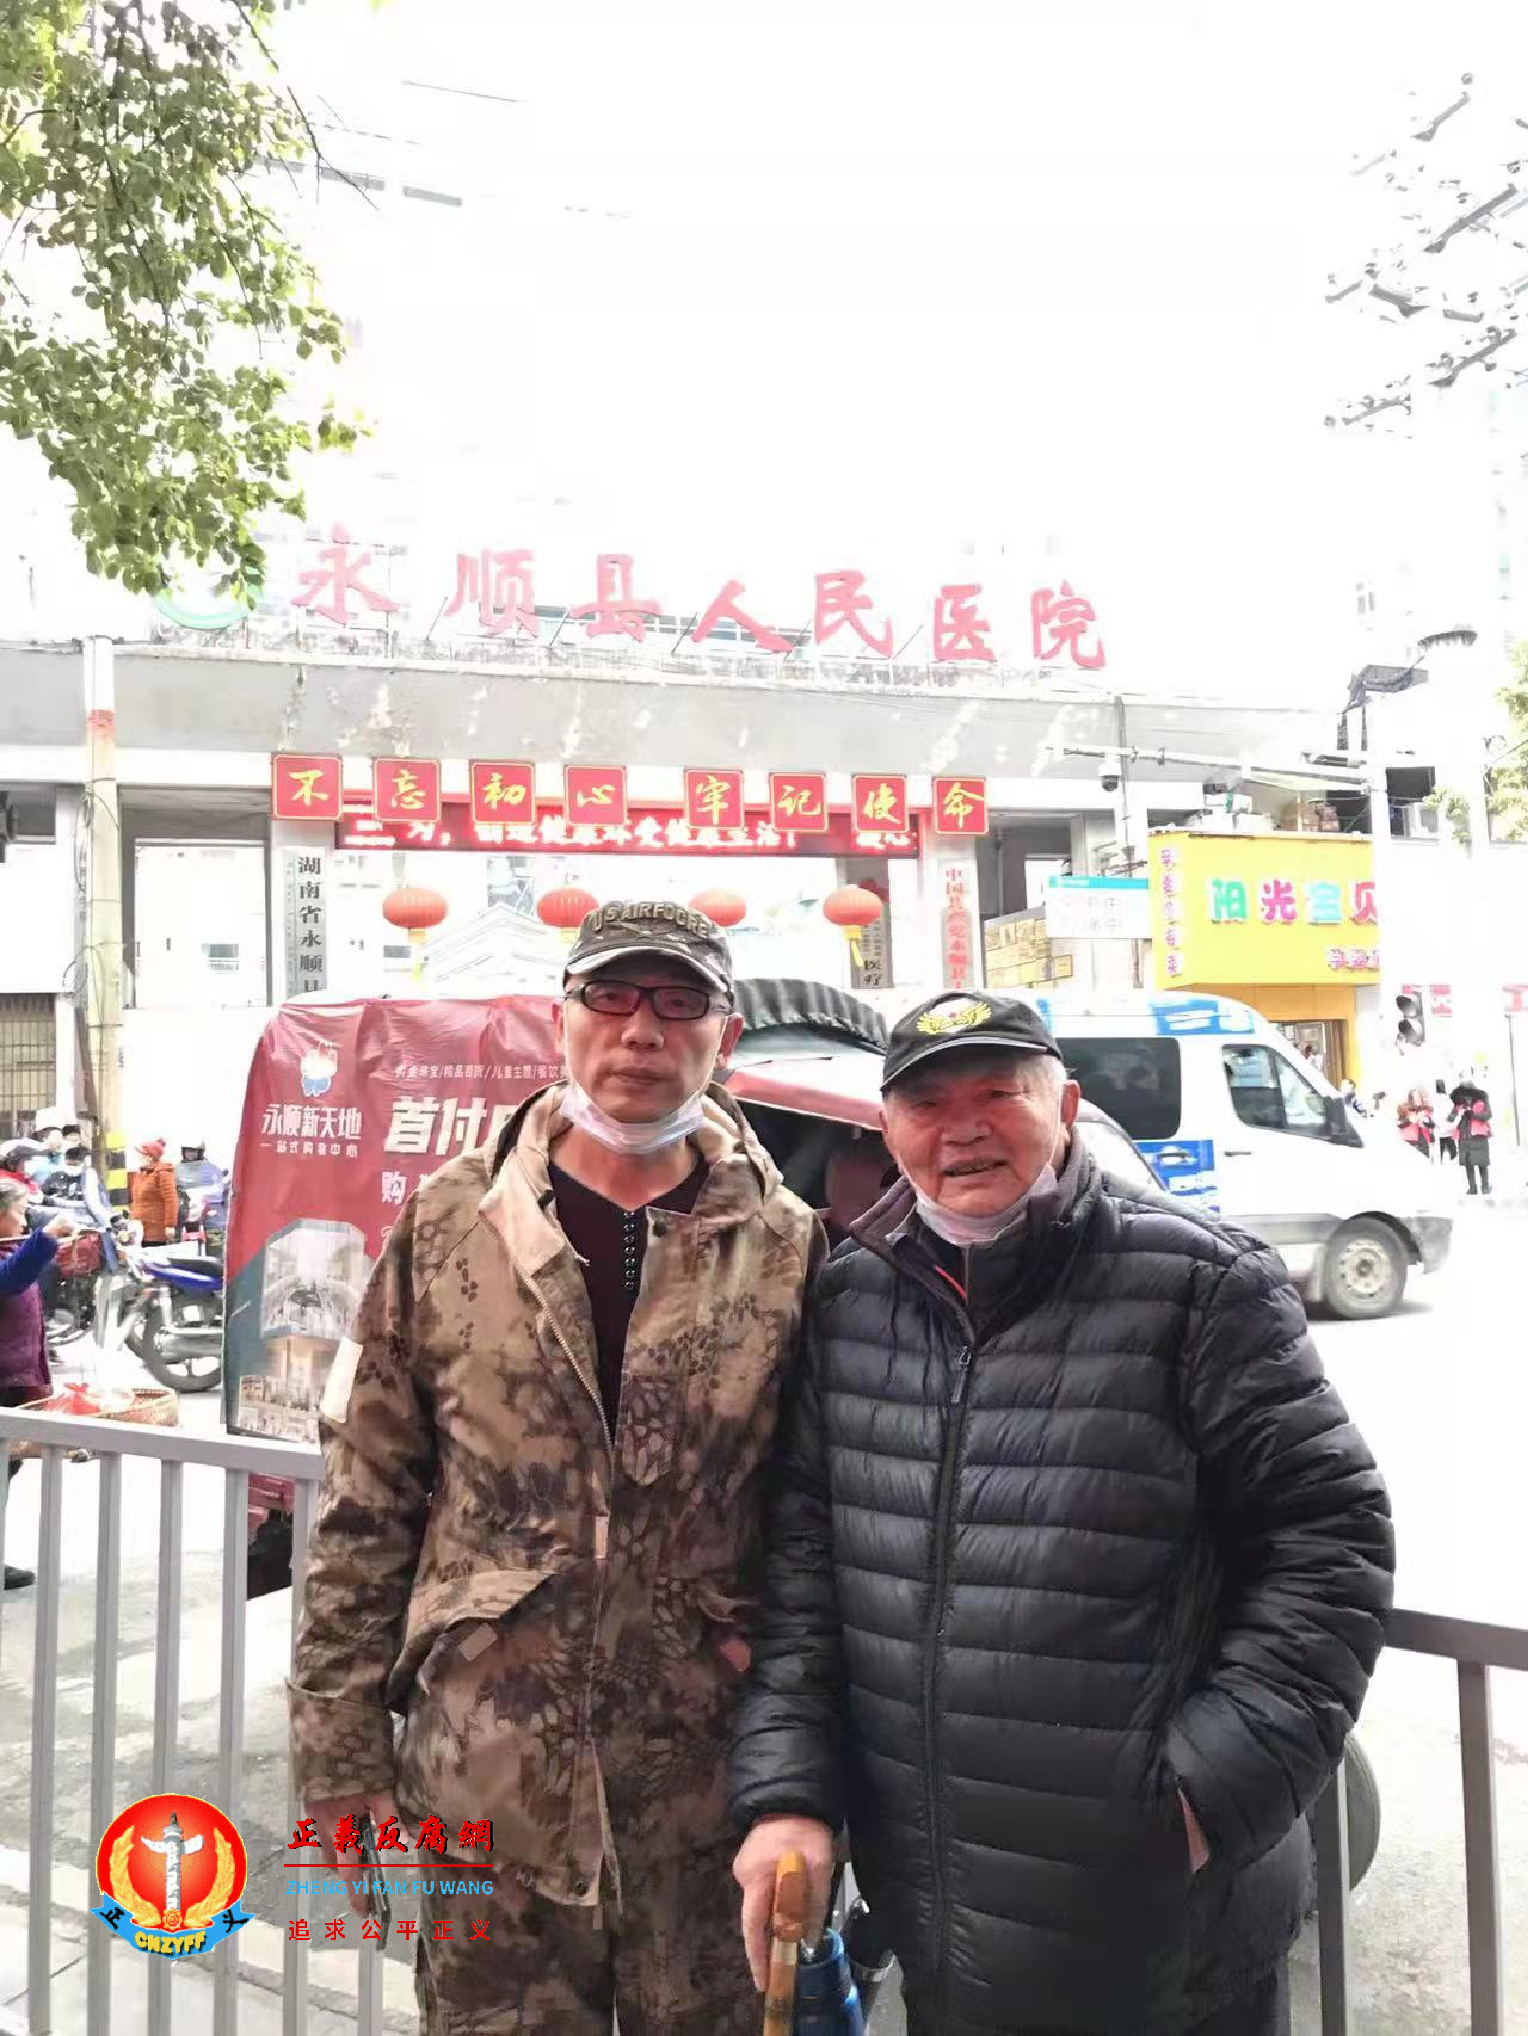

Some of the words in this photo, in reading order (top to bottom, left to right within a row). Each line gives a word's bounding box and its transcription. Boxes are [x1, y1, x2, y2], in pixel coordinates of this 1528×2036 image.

[290, 522, 1106, 669] 永顺县人民医院
[288, 769, 985, 828] 不忘初心牢记使命
[260, 1103, 362, 1140] 永顺新天地
